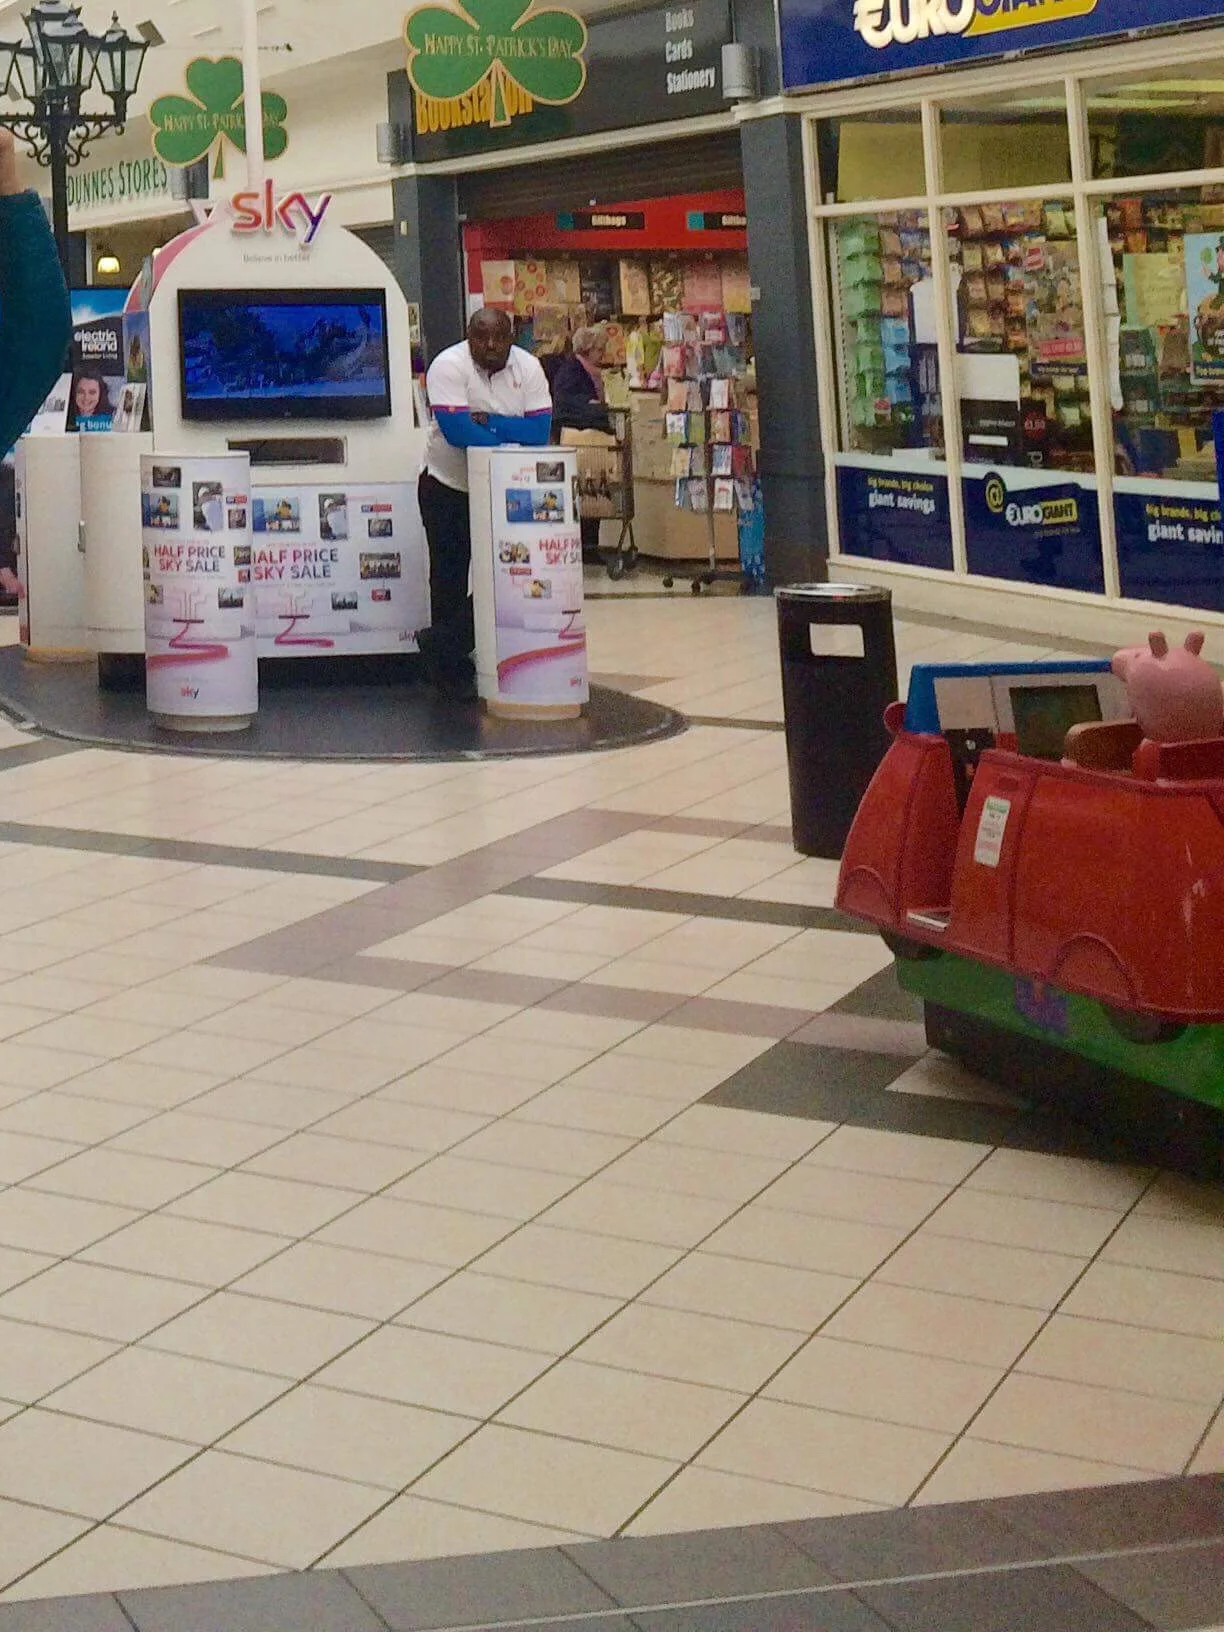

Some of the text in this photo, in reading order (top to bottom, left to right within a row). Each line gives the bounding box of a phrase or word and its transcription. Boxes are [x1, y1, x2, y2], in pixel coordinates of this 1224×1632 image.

[665, 8, 695, 33] Books
[424, 33, 464, 56] HAPPY
[547, 36, 574, 59] DAY
[665, 40, 693, 64] Cards
[666, 67, 717, 96] Stationery
[66, 157, 168, 207] DUNNES STORES
[231, 178, 333, 244] sky
[74, 329, 117, 343] electric
[868, 489, 936, 515] giant savings
[1147, 519, 1185, 542] giant
[154, 544, 225, 558] HALF PRICE
[292, 548, 339, 563] PRICE
[159, 558, 220, 573] SKY SALE
[254, 564, 332, 581] SKY SALE
[180, 685, 200, 700] sky
